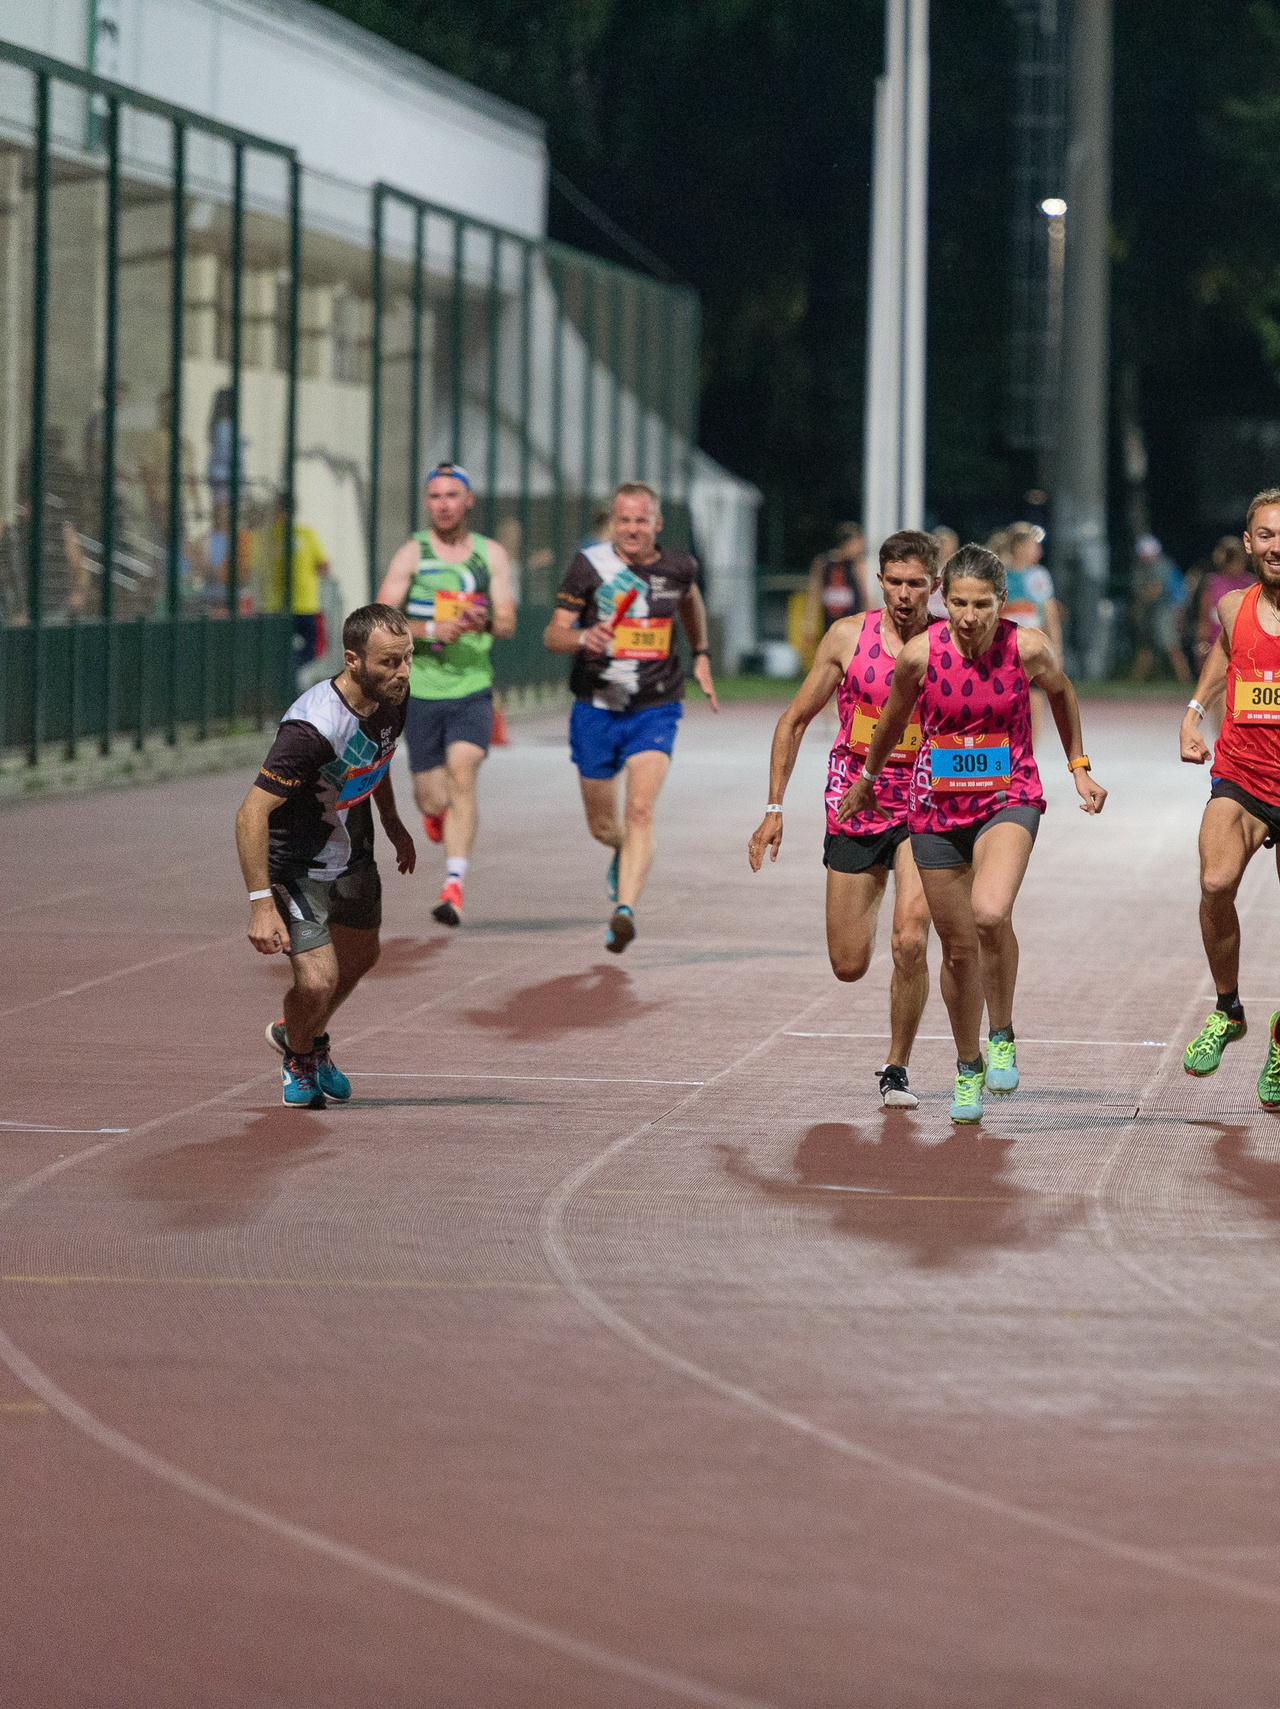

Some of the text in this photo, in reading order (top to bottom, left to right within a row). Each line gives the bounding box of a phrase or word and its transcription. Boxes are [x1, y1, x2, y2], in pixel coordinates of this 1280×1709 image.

[910, 736, 917, 746] 2
[952, 754, 1002, 772] 309 3
